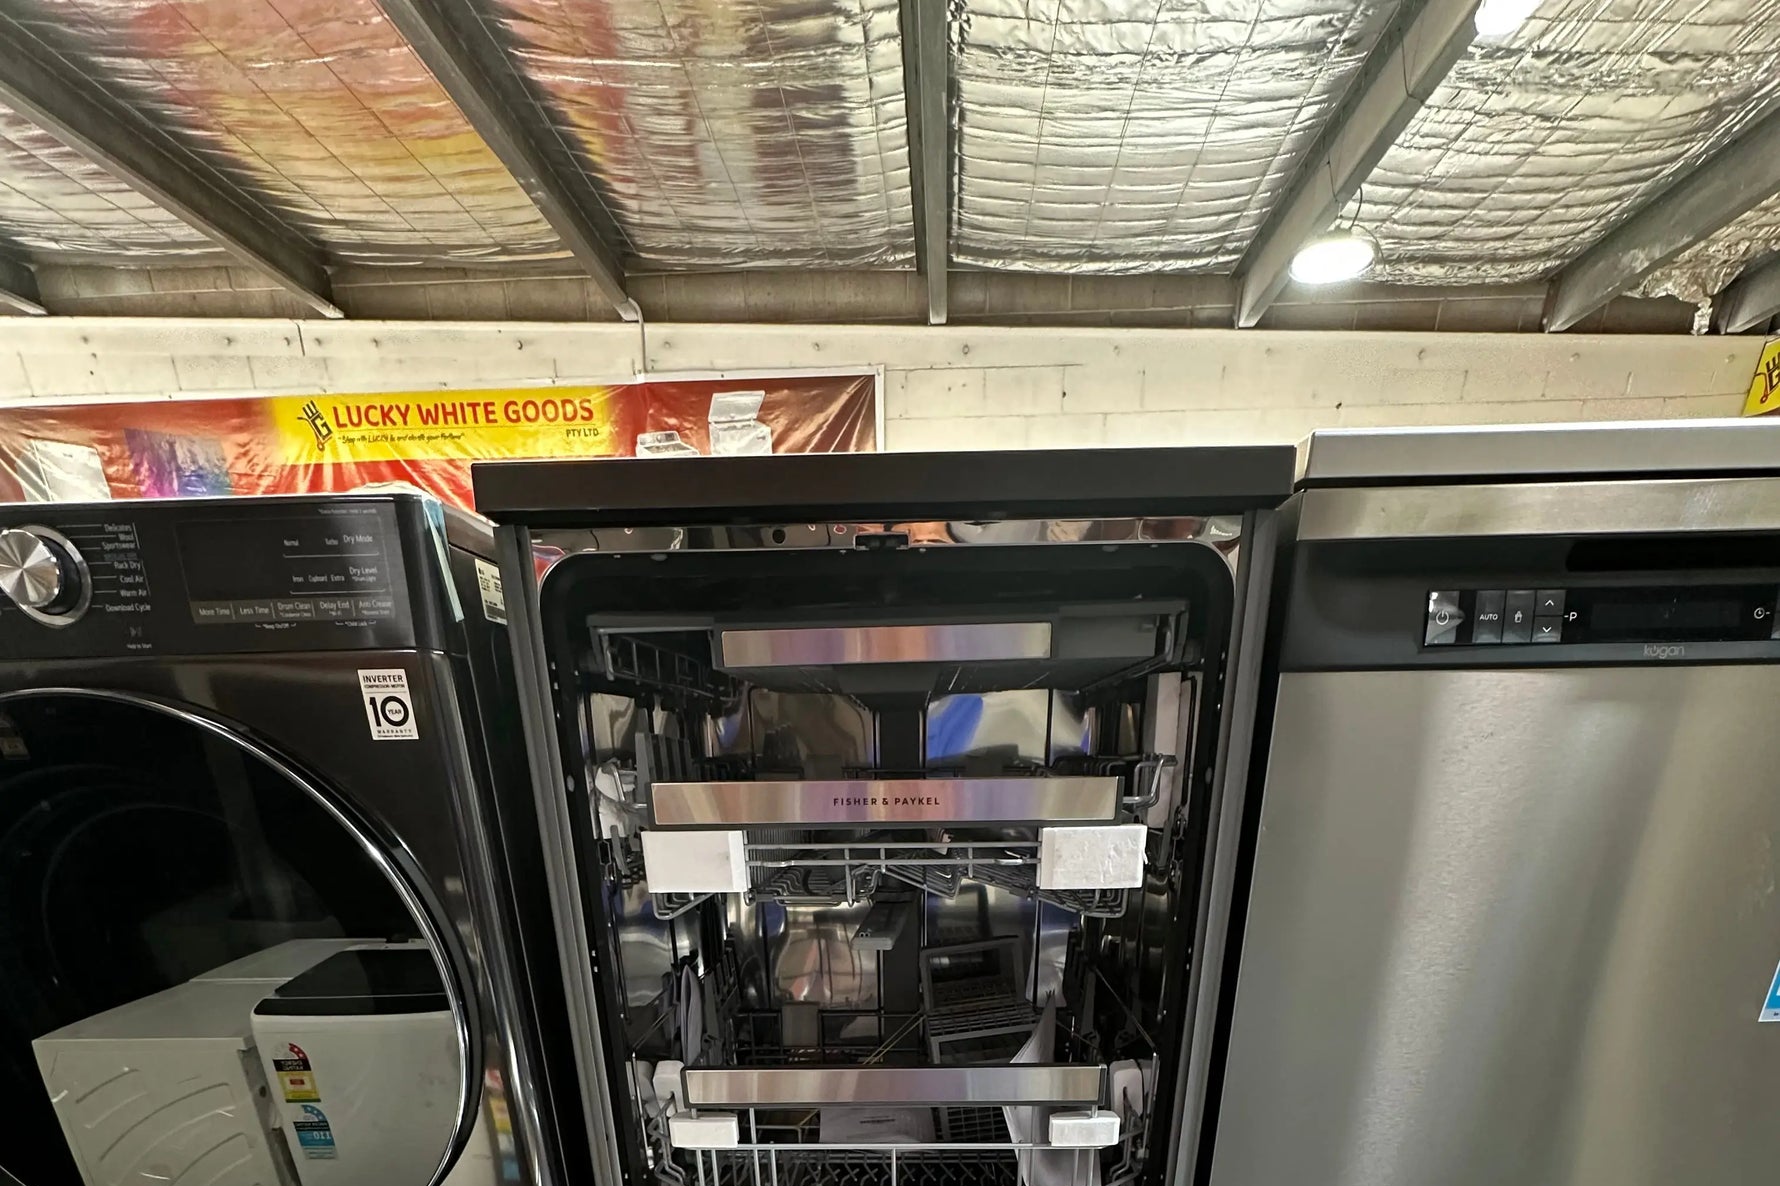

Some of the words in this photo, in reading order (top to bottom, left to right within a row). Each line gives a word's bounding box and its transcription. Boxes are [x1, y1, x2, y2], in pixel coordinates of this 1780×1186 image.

[333, 402, 410, 428] LUCKY
[416, 401, 498, 426] WHITE
[503, 398, 594, 423] GOODS
[566, 429, 582, 438] PTY
[583, 428, 599, 438] LTD
[343, 534, 356, 544] Dry
[356, 534, 373, 543] Mode
[102, 541, 136, 551] Sportswear
[130, 561, 140, 571] Dry
[349, 566, 361, 576] Dry
[361, 566, 378, 574] Level
[120, 575, 134, 583] Cool
[135, 575, 144, 583] Air
[120, 589, 137, 597] Warm
[138, 588, 147, 597] Air
[105, 603, 134, 612] Download
[135, 603, 151, 613] Cycle
[277, 602, 293, 611] Drum
[294, 602, 311, 610] Clean
[320, 601, 337, 610] Delay
[337, 600, 349, 609] End
[199, 607, 215, 616] More
[216, 607, 230, 616] Time
[240, 607, 254, 616] Less
[255, 606, 269, 615] Time
[1479, 613, 1499, 622] AUTO
[1643, 644, 1685, 659] kogan
[363, 674, 404, 683] INVERTER
[369, 696, 410, 727] 10
[833, 798, 878, 806] FISHER
[882, 798, 889, 806] &
[895, 797, 940, 806] PAYKEL
